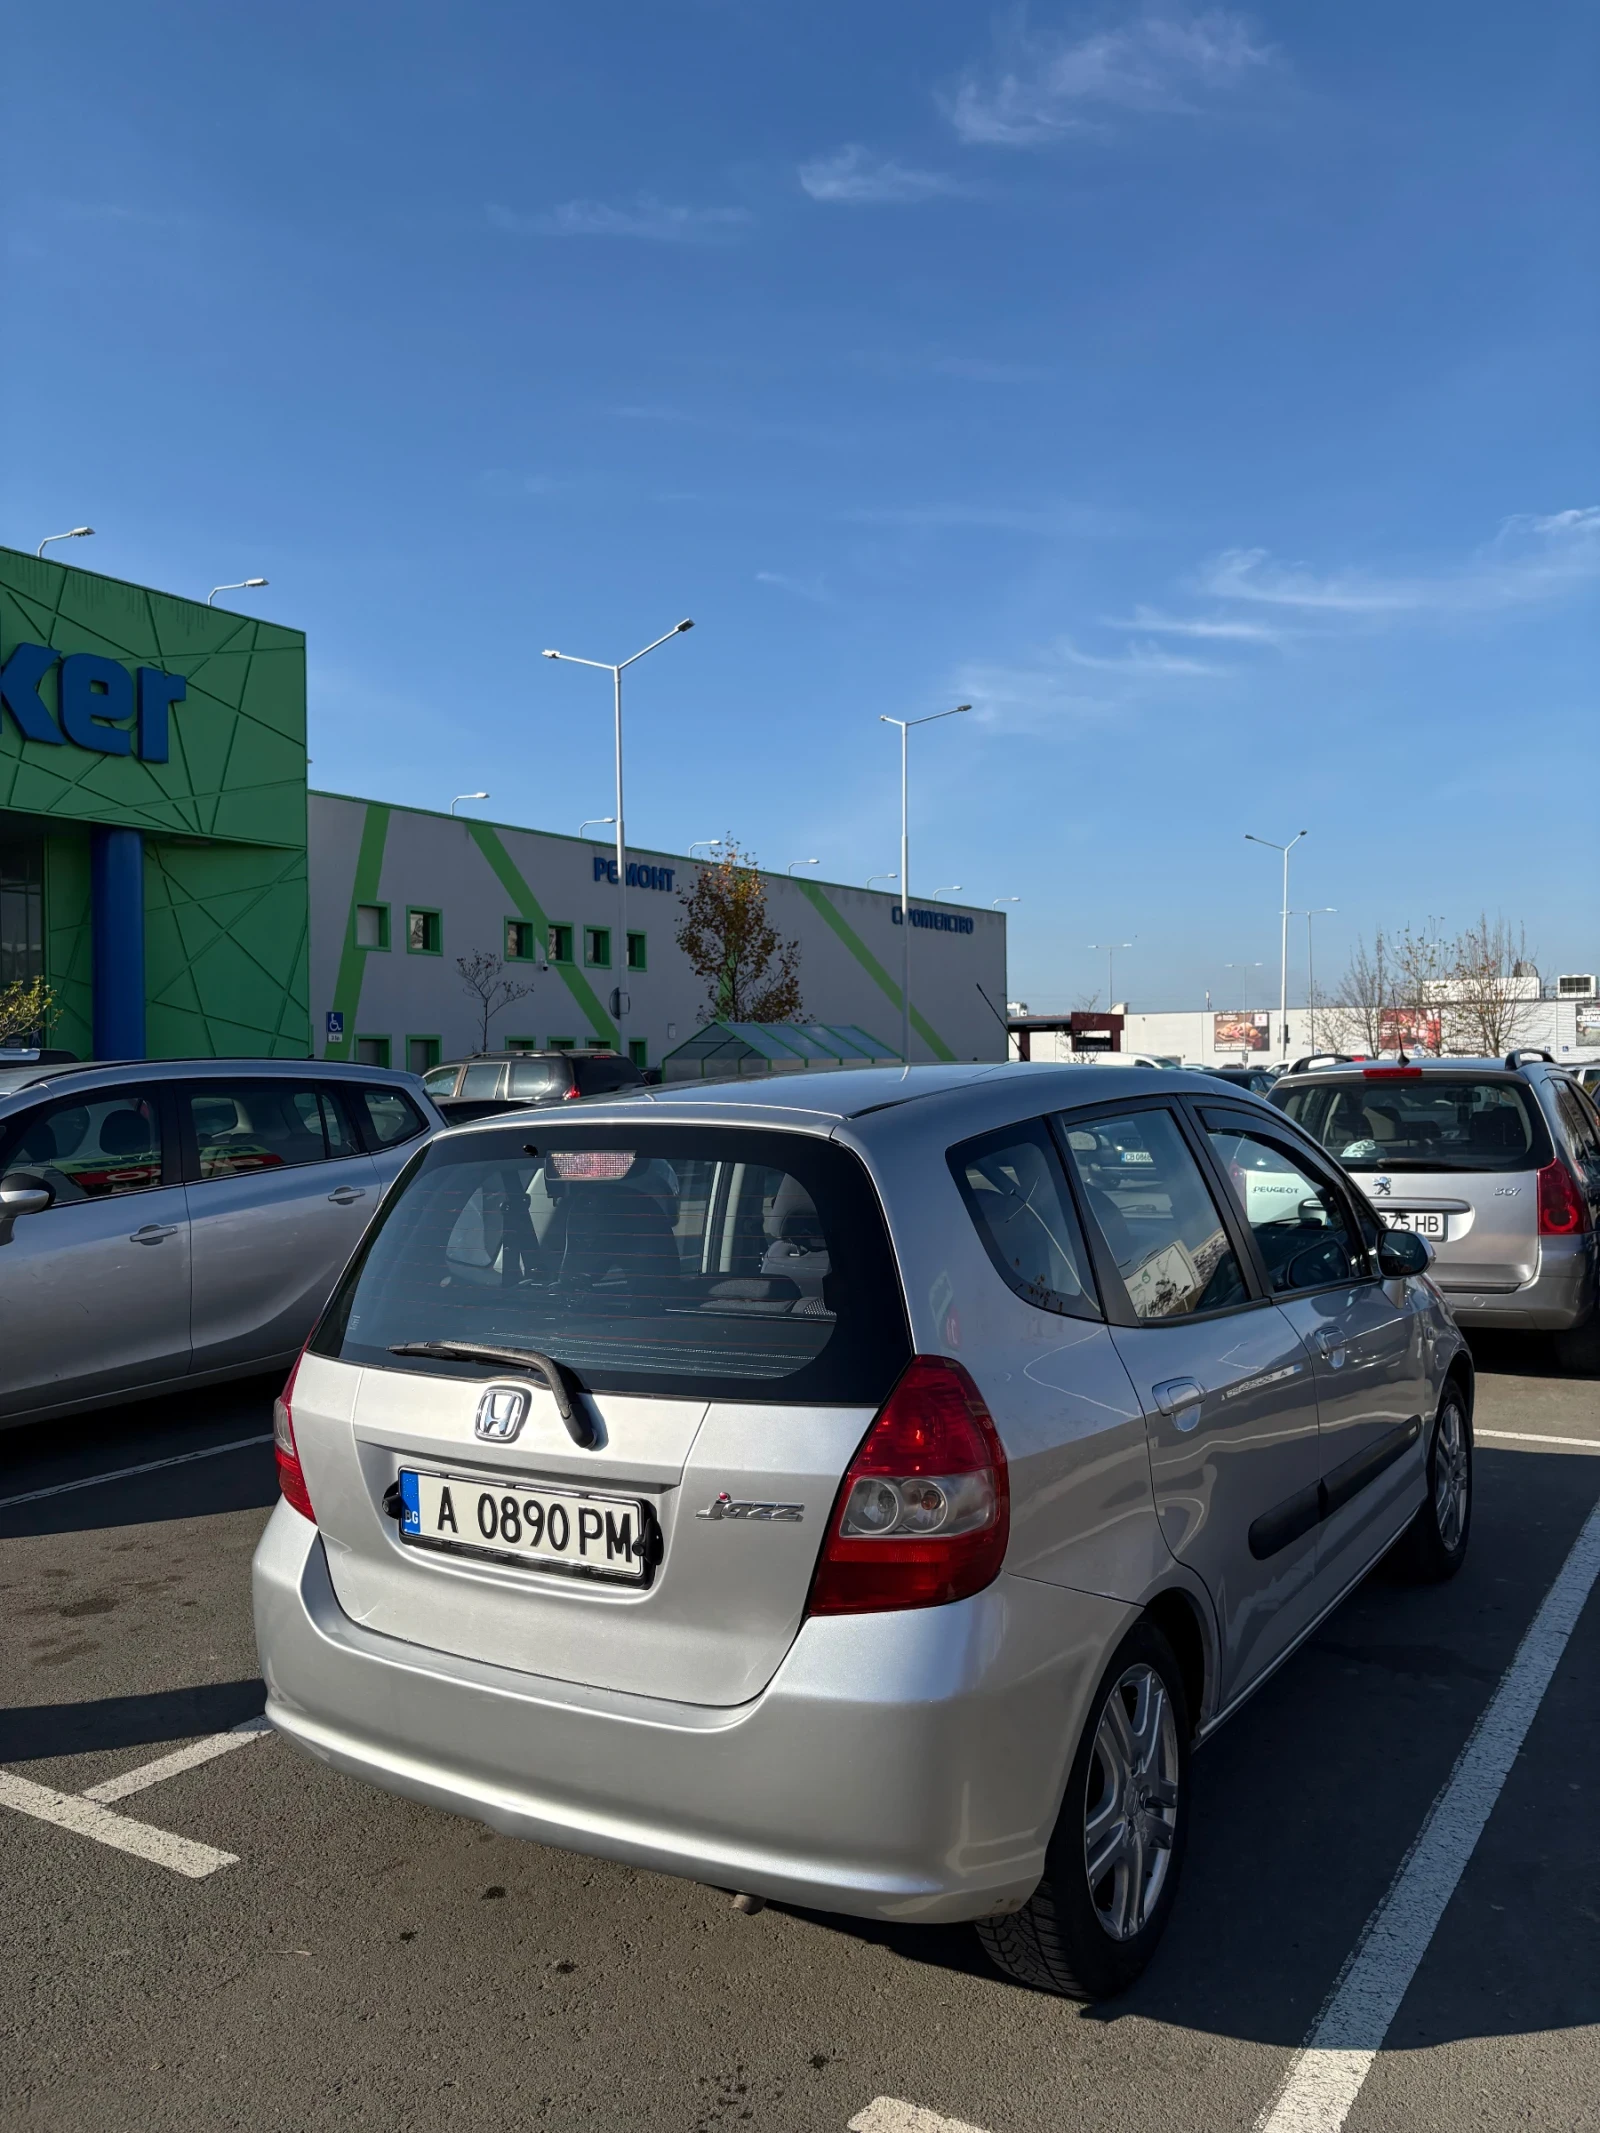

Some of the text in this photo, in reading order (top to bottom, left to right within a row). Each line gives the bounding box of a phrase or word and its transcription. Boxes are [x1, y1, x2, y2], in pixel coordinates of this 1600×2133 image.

[1252, 1185, 1300, 1194] PEUGEOT
[404, 1509, 419, 1525] BG
[436, 1485, 459, 1534] A
